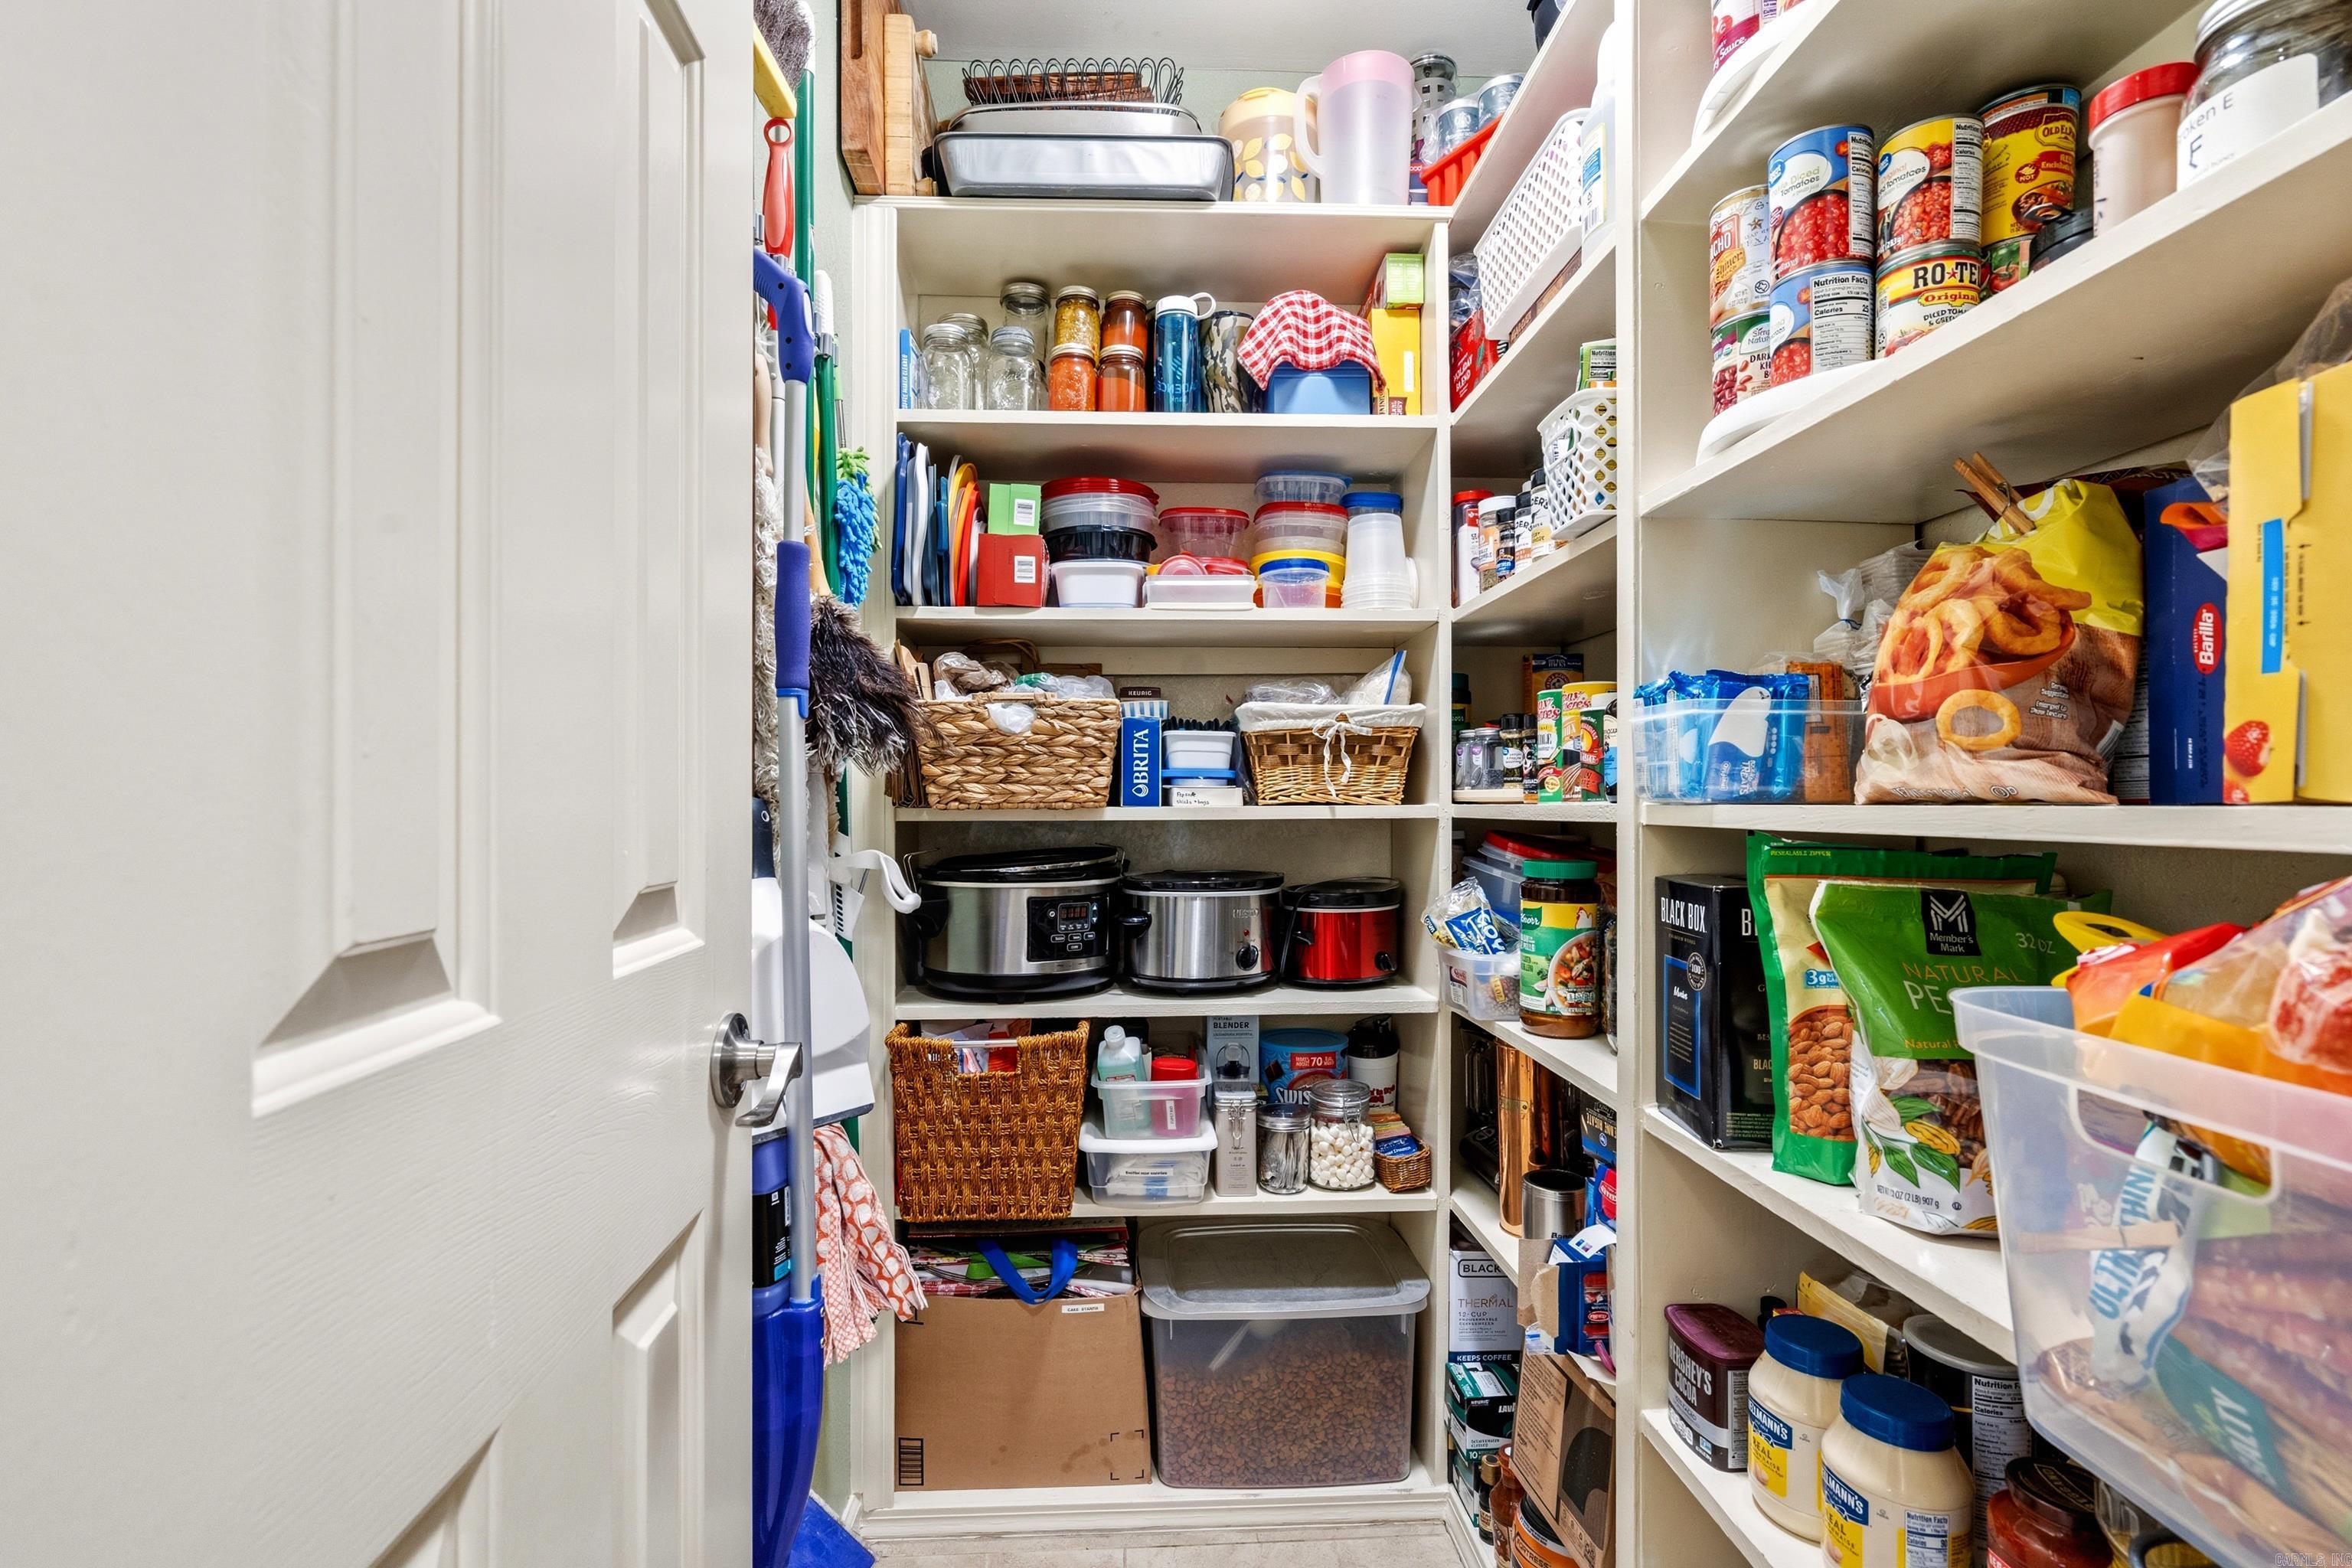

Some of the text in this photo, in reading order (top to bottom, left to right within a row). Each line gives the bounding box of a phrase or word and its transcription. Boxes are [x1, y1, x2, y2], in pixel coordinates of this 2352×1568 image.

[2181, 106, 2216, 139] oken
[2042, 125, 2061, 138] OLD
[1790, 165, 1820, 183] Diced
[1813, 275, 1868, 288] Nutrition Facts
[1814, 304, 1869, 316] Calories 25
[1923, 308, 1947, 321] DICED
[2198, 612, 2215, 665] Barilla
[1133, 728, 1149, 783] BRITA
[1739, 761, 1750, 795] TREATS
[1521, 913, 1540, 926] Knorr
[1660, 897, 1706, 933] BLACK BOX
[1929, 933, 1975, 946] Member's
[2015, 933, 2057, 955] 32 OZ
[1939, 943, 1965, 954] Mark
[1901, 962, 2026, 985] NATURAL
[1213, 1021, 1250, 1029] BLENDER
[1905, 1038, 1952, 1050] Natural
[1310, 1057, 1323, 1067] 70
[1911, 1194, 1922, 1205] LB)
[1922, 1196, 1934, 1206] 907
[1934, 1200, 1940, 1210] g
[1462, 1264, 1501, 1273] BLACK
[1458, 1298, 1514, 1308] THERMAL
[1457, 1353, 1513, 1362] KEEPS COFFEE
[1668, 1334, 1713, 1396] HERSHEY'S
[1674, 1367, 1697, 1407] COCOA
[1974, 1378, 2013, 1390] Nutrition
[1974, 1406, 2004, 1416] Calories
[1749, 1400, 1788, 1441] ELLMANN'S
[1469, 1451, 1478, 1459] 10
[1821, 1468, 1864, 1515] ELLMANN'S
[1906, 1511, 1948, 1524] Nutrition Facts
[1906, 1537, 1948, 1547] Calories 90
[1517, 1537, 1552, 1568] FORTRESS
